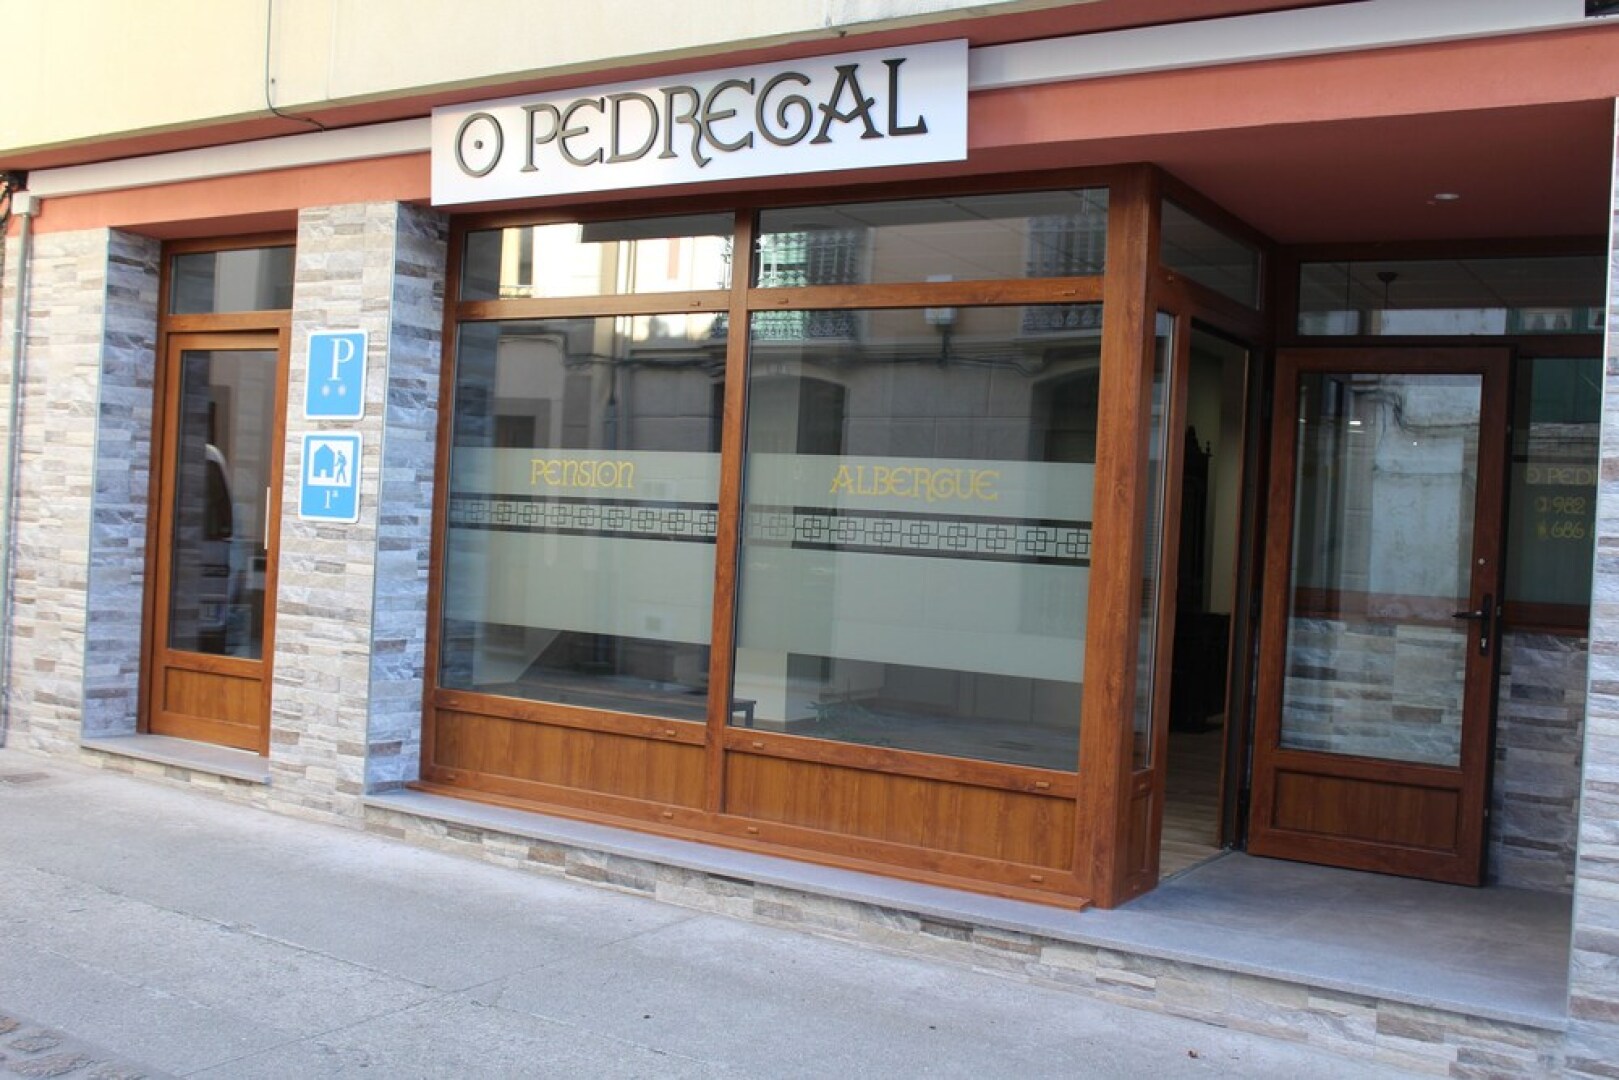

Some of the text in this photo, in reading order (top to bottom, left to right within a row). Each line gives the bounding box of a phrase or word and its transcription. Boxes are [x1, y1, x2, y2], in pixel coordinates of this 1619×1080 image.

[454, 58, 928, 177] O PEDREGAL
[327, 337, 355, 382] P
[530, 459, 635, 489] PENSION
[830, 464, 1000, 502] ALBERGUE
